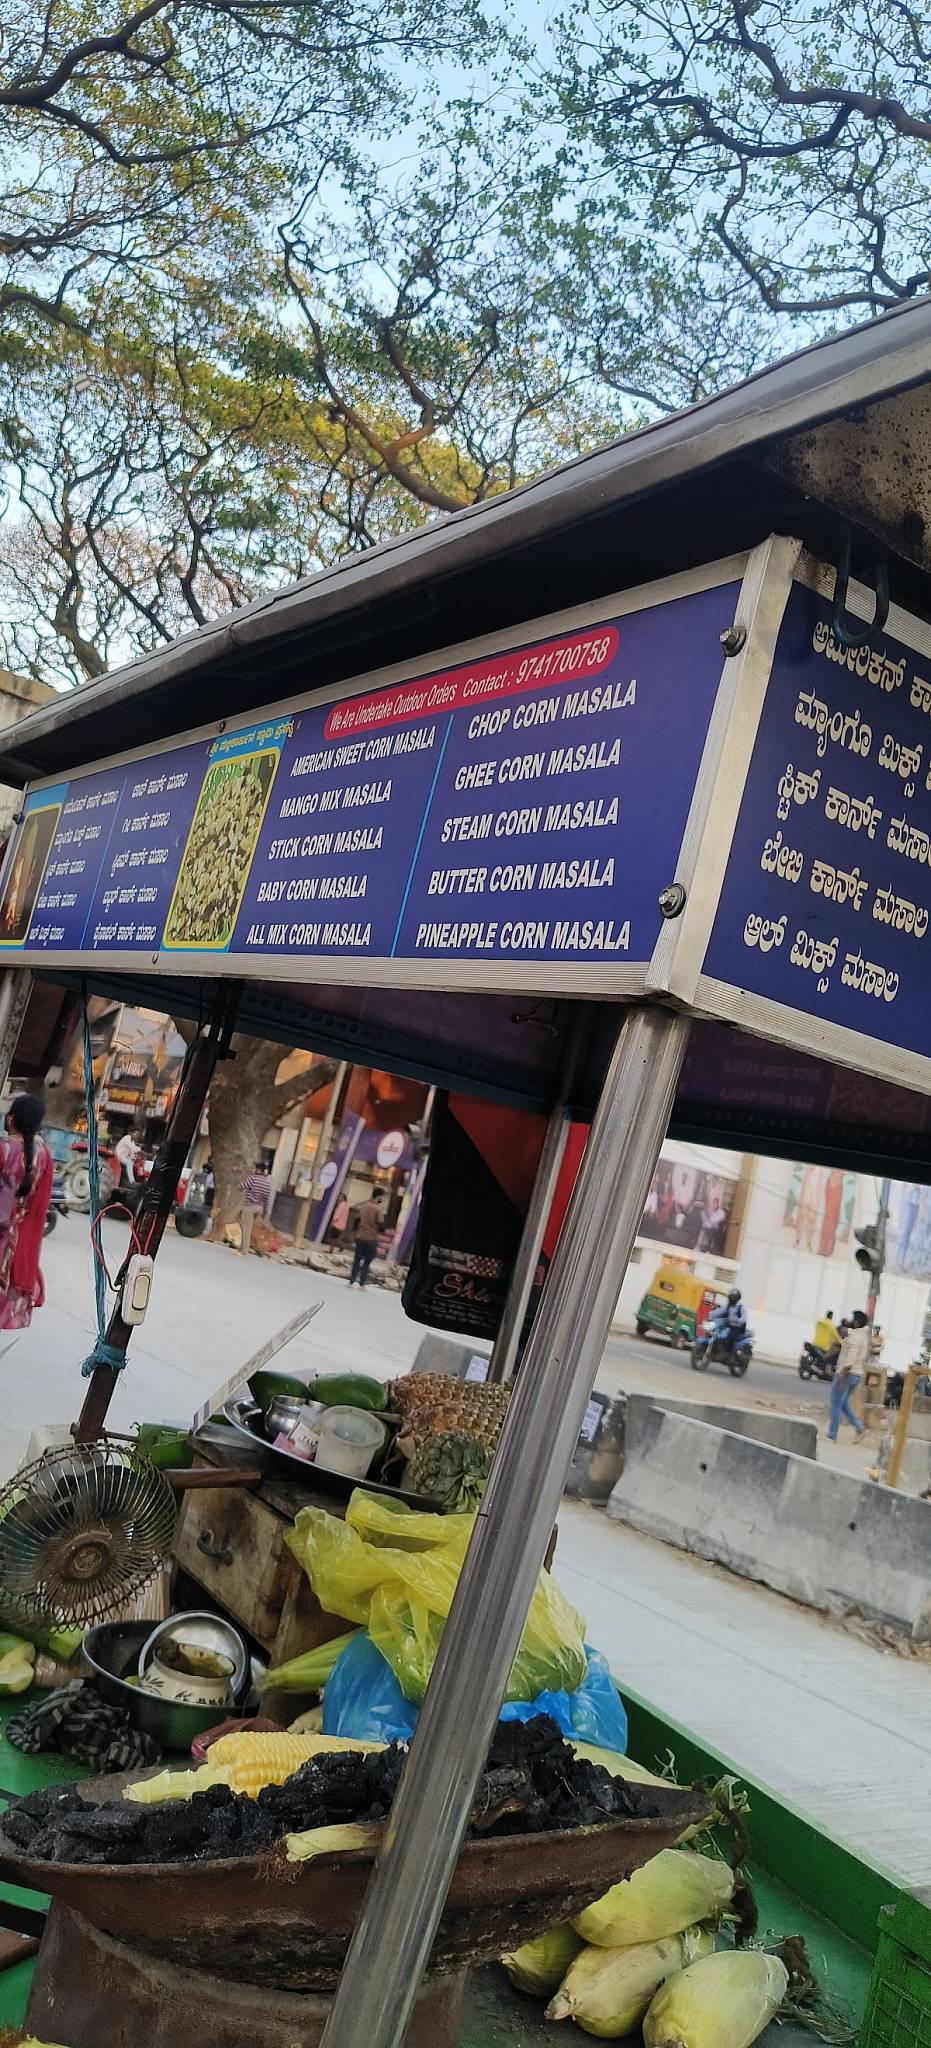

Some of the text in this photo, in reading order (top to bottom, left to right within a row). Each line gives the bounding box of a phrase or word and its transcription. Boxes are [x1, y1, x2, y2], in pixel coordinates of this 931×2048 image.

[329, 711, 342, 732] We
[340, 708, 355, 728] Are
[354, 698, 394, 724] Undertake
[393, 689, 429, 716] Outdoor
[427, 681, 458, 707] Orders
[463, 671, 508, 698] Contact
[515, 636, 611, 685] 9741700758
[468, 679, 637, 740] CHOP CORN MASALA
[290, 726, 436, 777] AMERICAN SWEET CORN MASALA
[454, 738, 621, 791] GHEE CORN MASALA
[878, 734, 923, 798] ಮಿಕ್ಸ್
[279, 780, 392, 819] MANGO MIX MASALA
[441, 797, 619, 843] STEAM CORN MASALA
[777, 763, 822, 821] ಸ್ಟಿಕ್
[825, 786, 883, 840] ಕಾರ್ನ್
[268, 827, 384, 860] STICK CORN MASALA
[257, 875, 368, 902] BABY CORN MASALA
[428, 858, 615, 895] BUTTER CORN MASALA
[760, 830, 929, 938] ಬೇಬಿ ಕಾರ್ನ್ ಮಸಾಲ
[246, 923, 372, 946] ALL MIX CORN MASALA
[415, 921, 630, 950] PINEAPPLE CORN MASALA
[790, 929, 839, 993] ಮಿಕ್ಸ್
[841, 946, 899, 1002] ಮಸಾಲ
